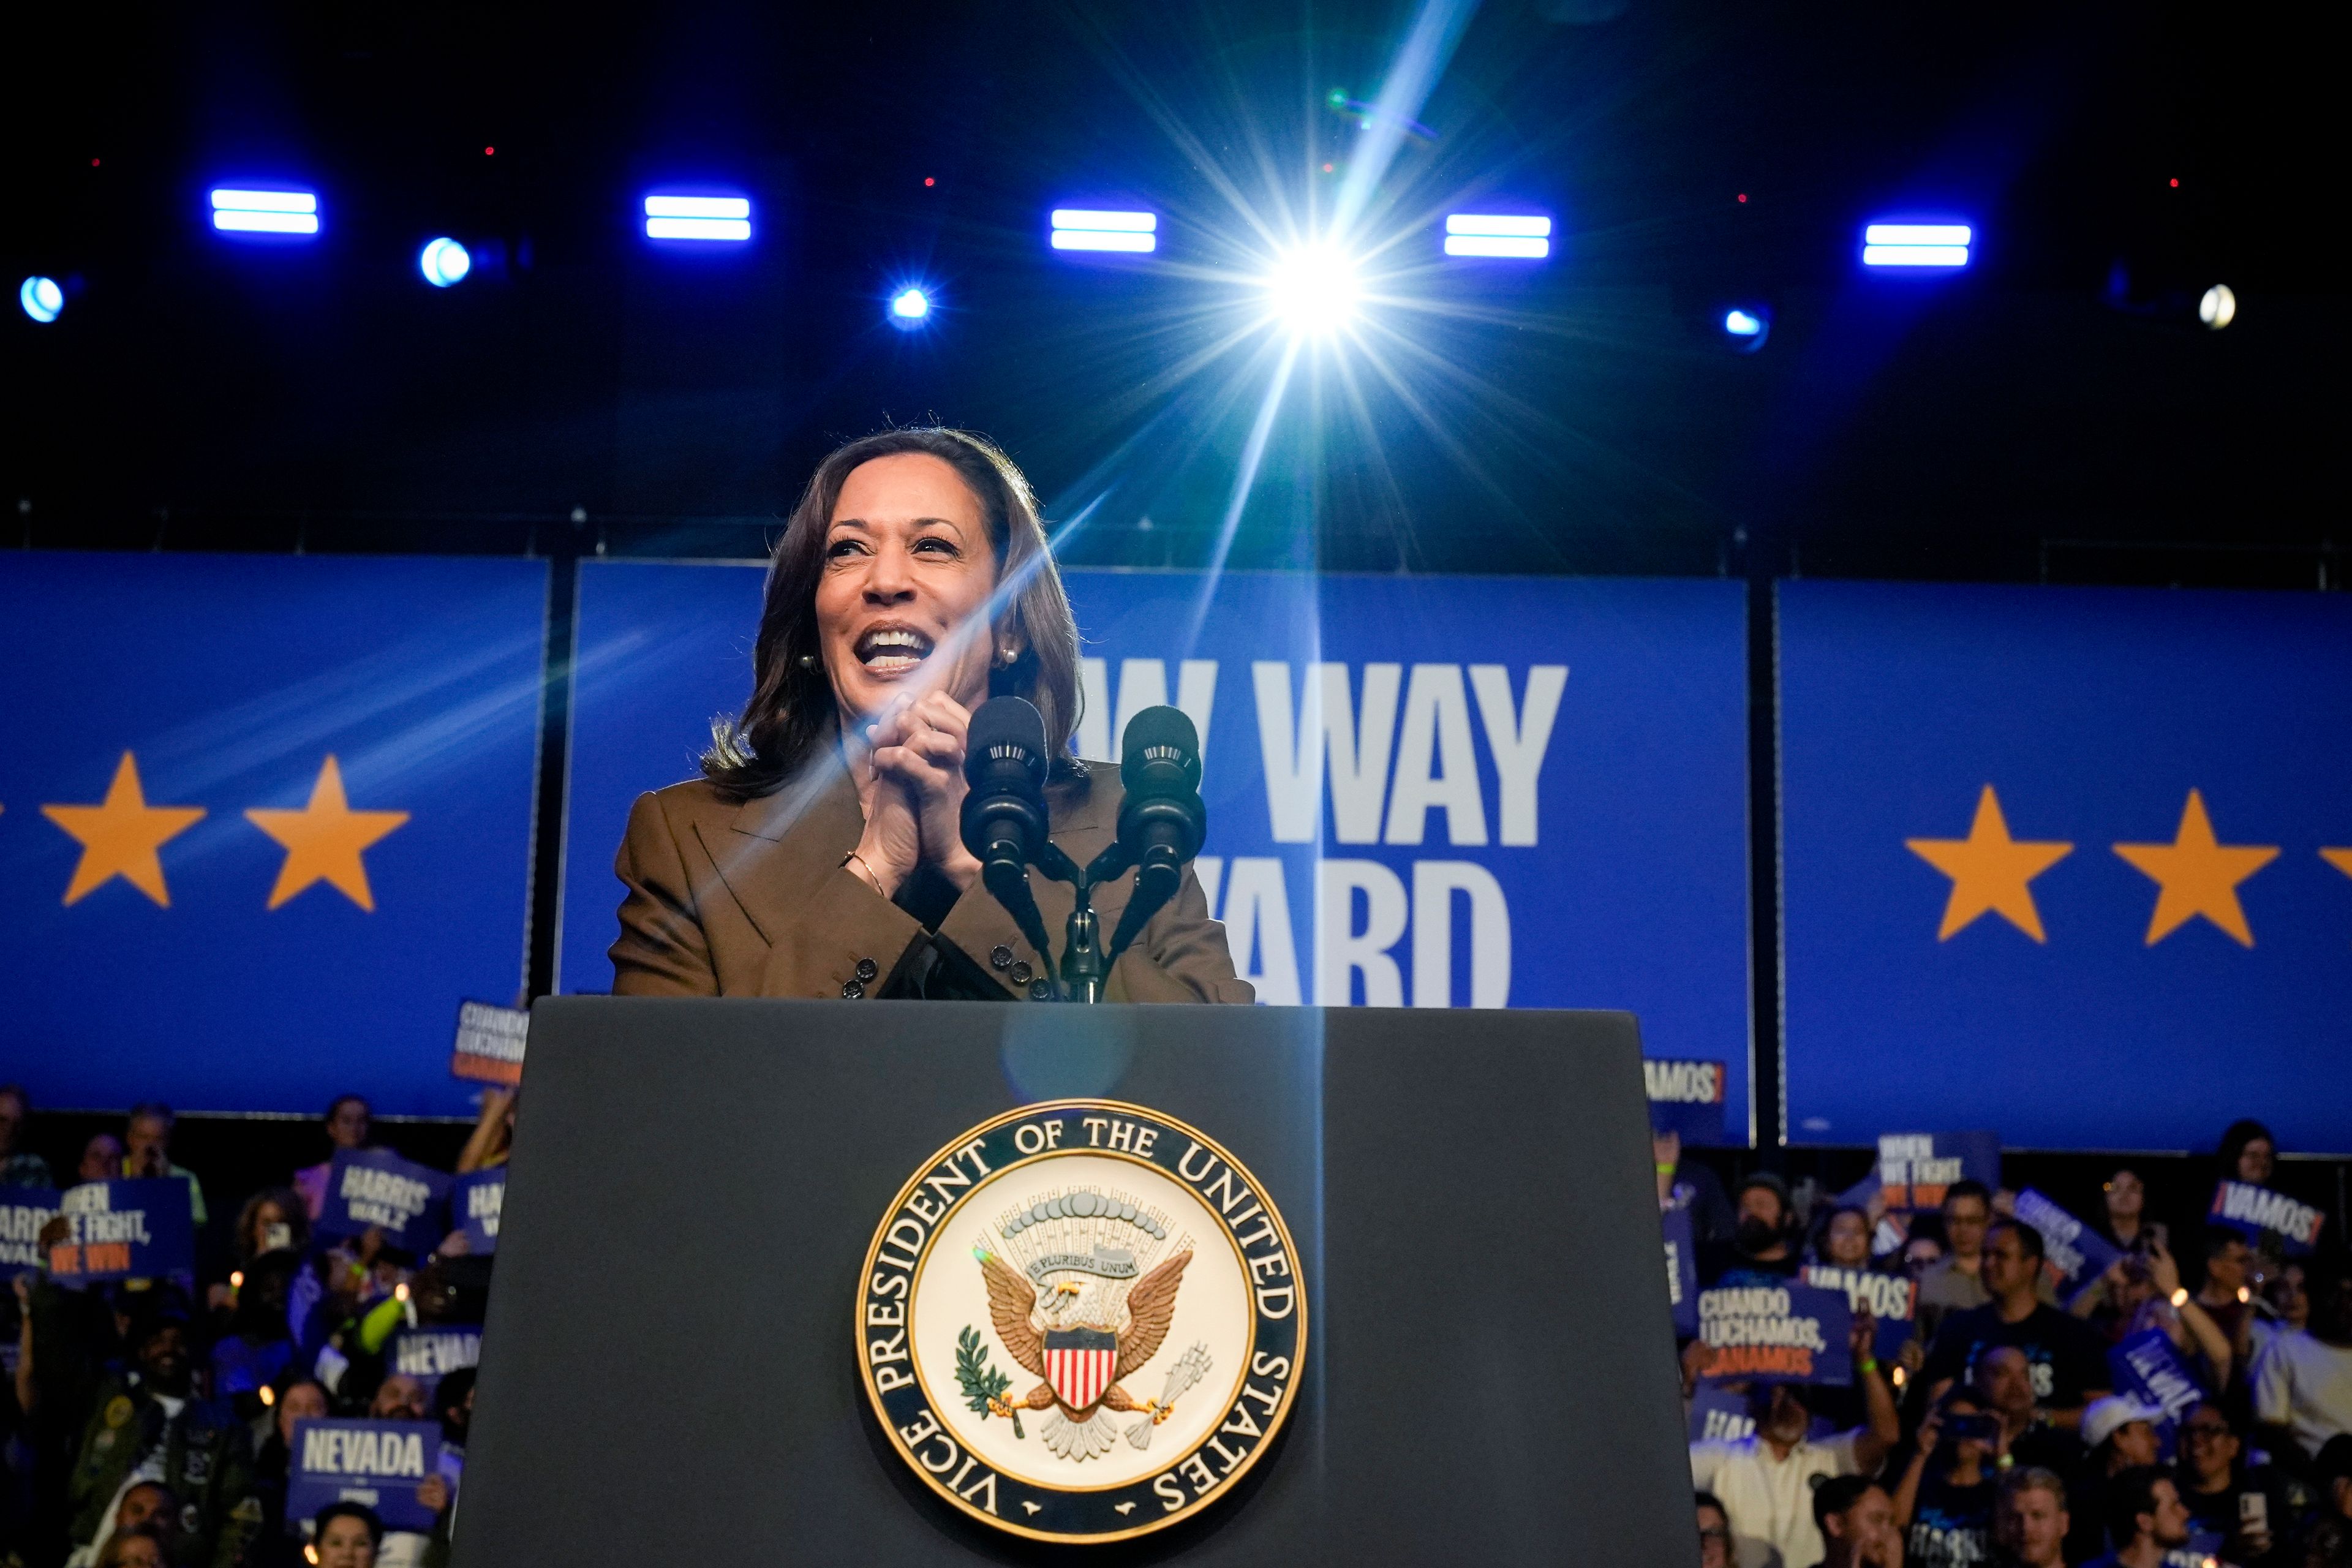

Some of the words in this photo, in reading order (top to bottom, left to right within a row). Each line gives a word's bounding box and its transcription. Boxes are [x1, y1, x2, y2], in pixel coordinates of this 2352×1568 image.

[1252, 661, 1569, 846] WAY
[1193, 856, 1512, 1009] ARD
[1014, 1119, 1064, 1155] OF
[1082, 1117, 1159, 1158] THE
[1178, 1141, 1295, 1320] UNITED
[867, 1138, 992, 1395] PRESIDENT
[1031, 1263, 1041, 1274] E
[1039, 1254, 1095, 1269] PLURIBUS
[1101, 1262, 1135, 1274] UNUM
[1698, 1287, 1791, 1319] CUANDO
[397, 1333, 482, 1375] NEVAD
[1699, 1317, 1827, 1354] LUCHAMOS,
[303, 1427, 424, 1477] NEVADA
[1153, 1351, 1290, 1512] STATES
[899, 1409, 998, 1516] VICE
